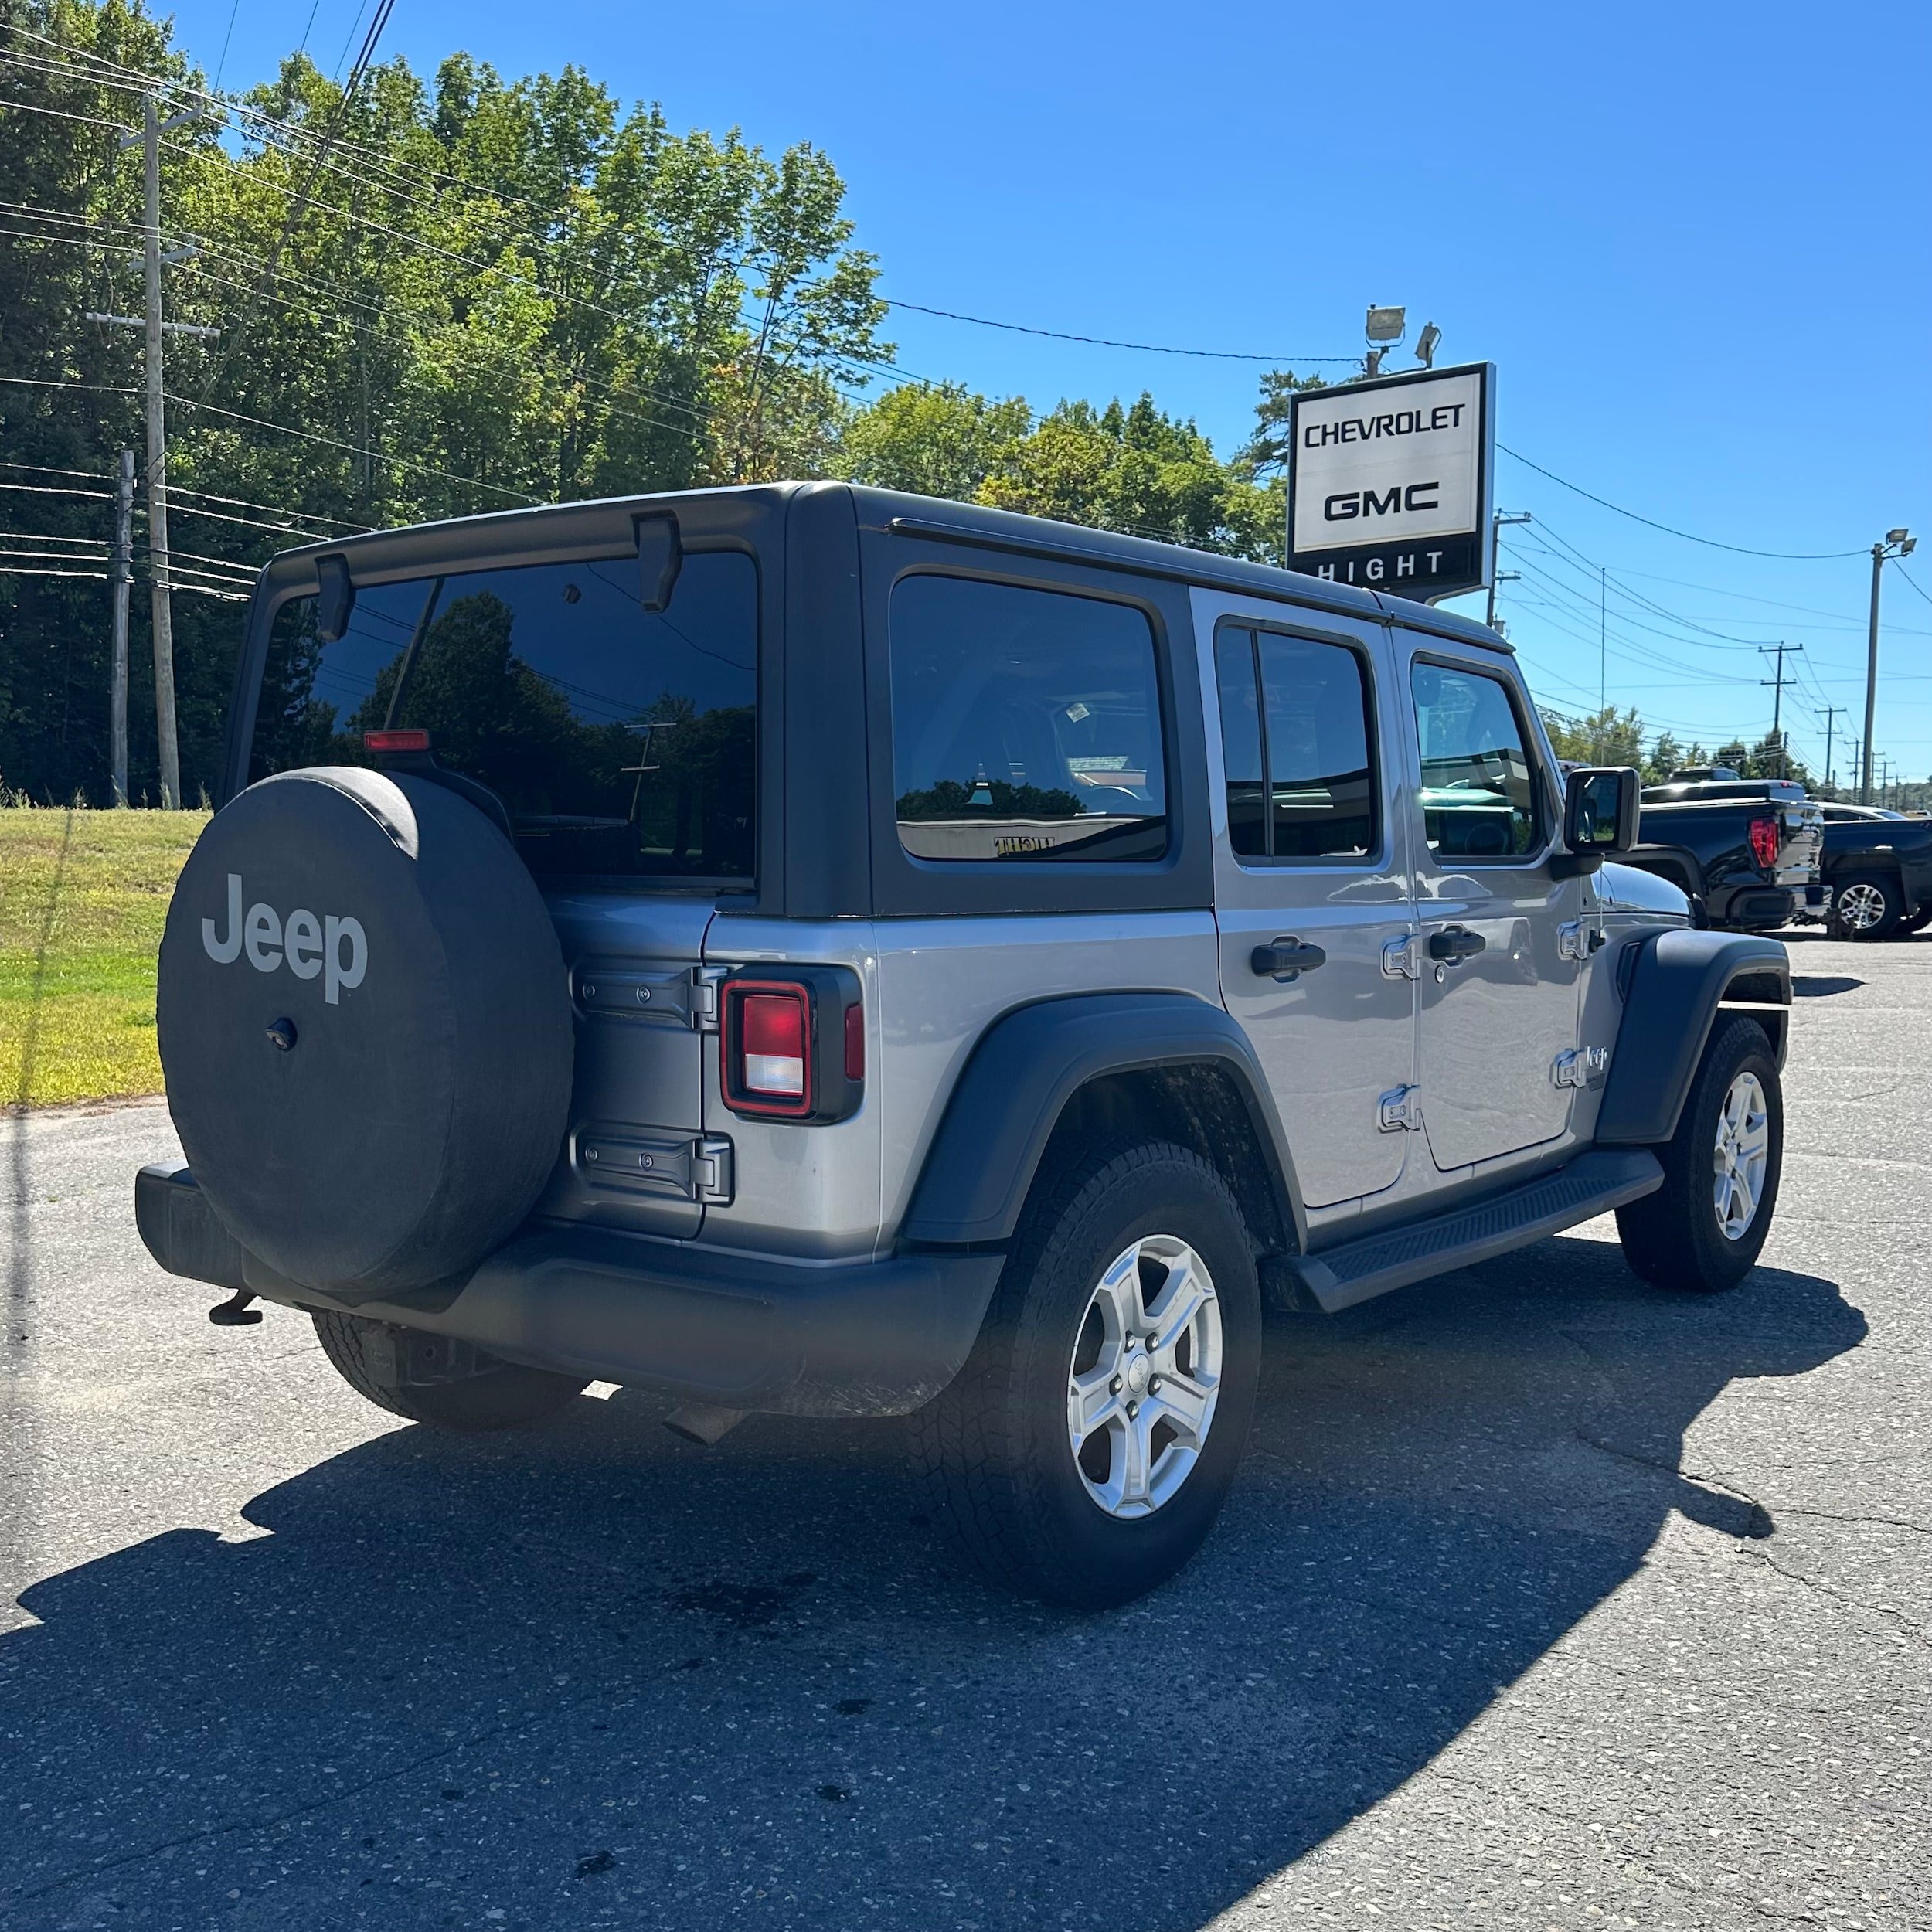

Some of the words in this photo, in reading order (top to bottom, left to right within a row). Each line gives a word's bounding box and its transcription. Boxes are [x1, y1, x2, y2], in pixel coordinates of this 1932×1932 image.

[1304, 403, 1465, 448] CHEVROLET
[1324, 481, 1439, 522] GMC
[1318, 551, 1443, 583] HIGHT
[202, 873, 368, 1005] Jeep
